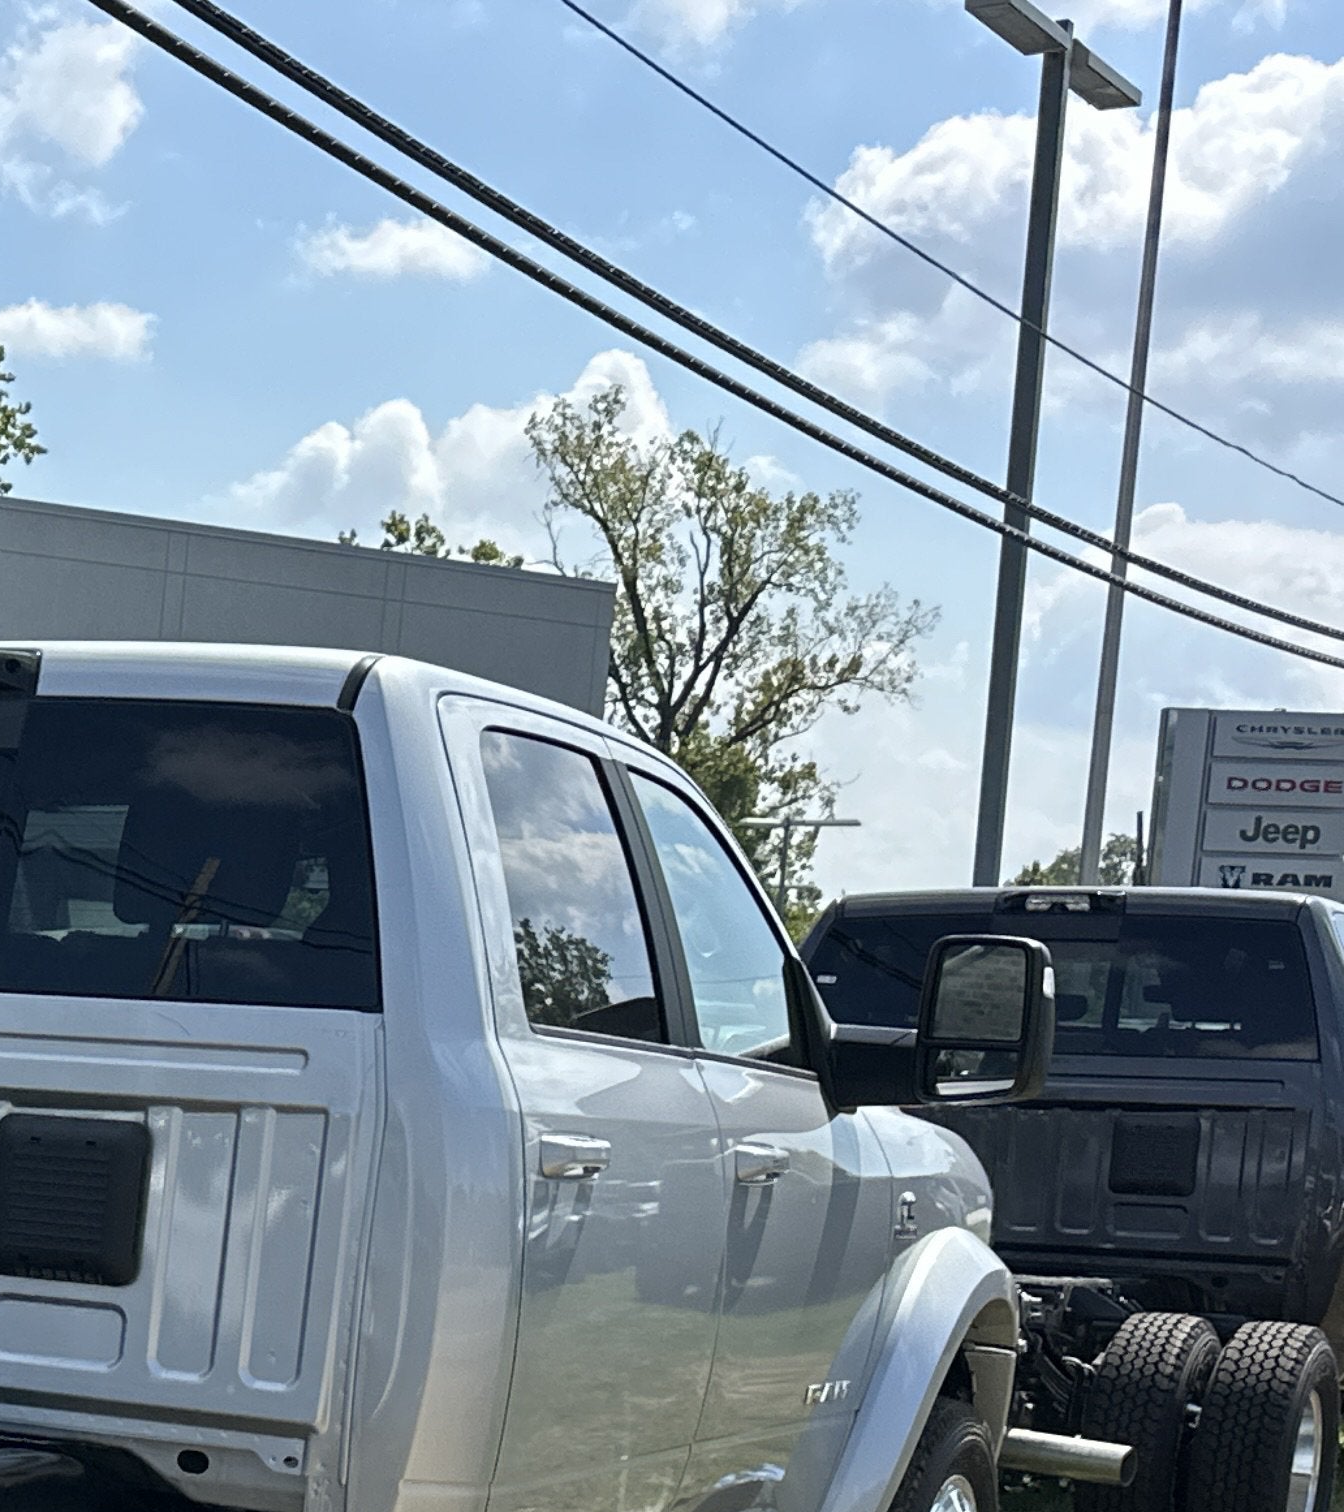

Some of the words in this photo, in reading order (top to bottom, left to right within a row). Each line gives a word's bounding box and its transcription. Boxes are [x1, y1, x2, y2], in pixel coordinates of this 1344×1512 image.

[1235, 724, 1344, 736] CHRYSLER
[1226, 776, 1343, 794] DODGE
[1239, 815, 1320, 849] Jeep
[1251, 872, 1332, 888] RAM
